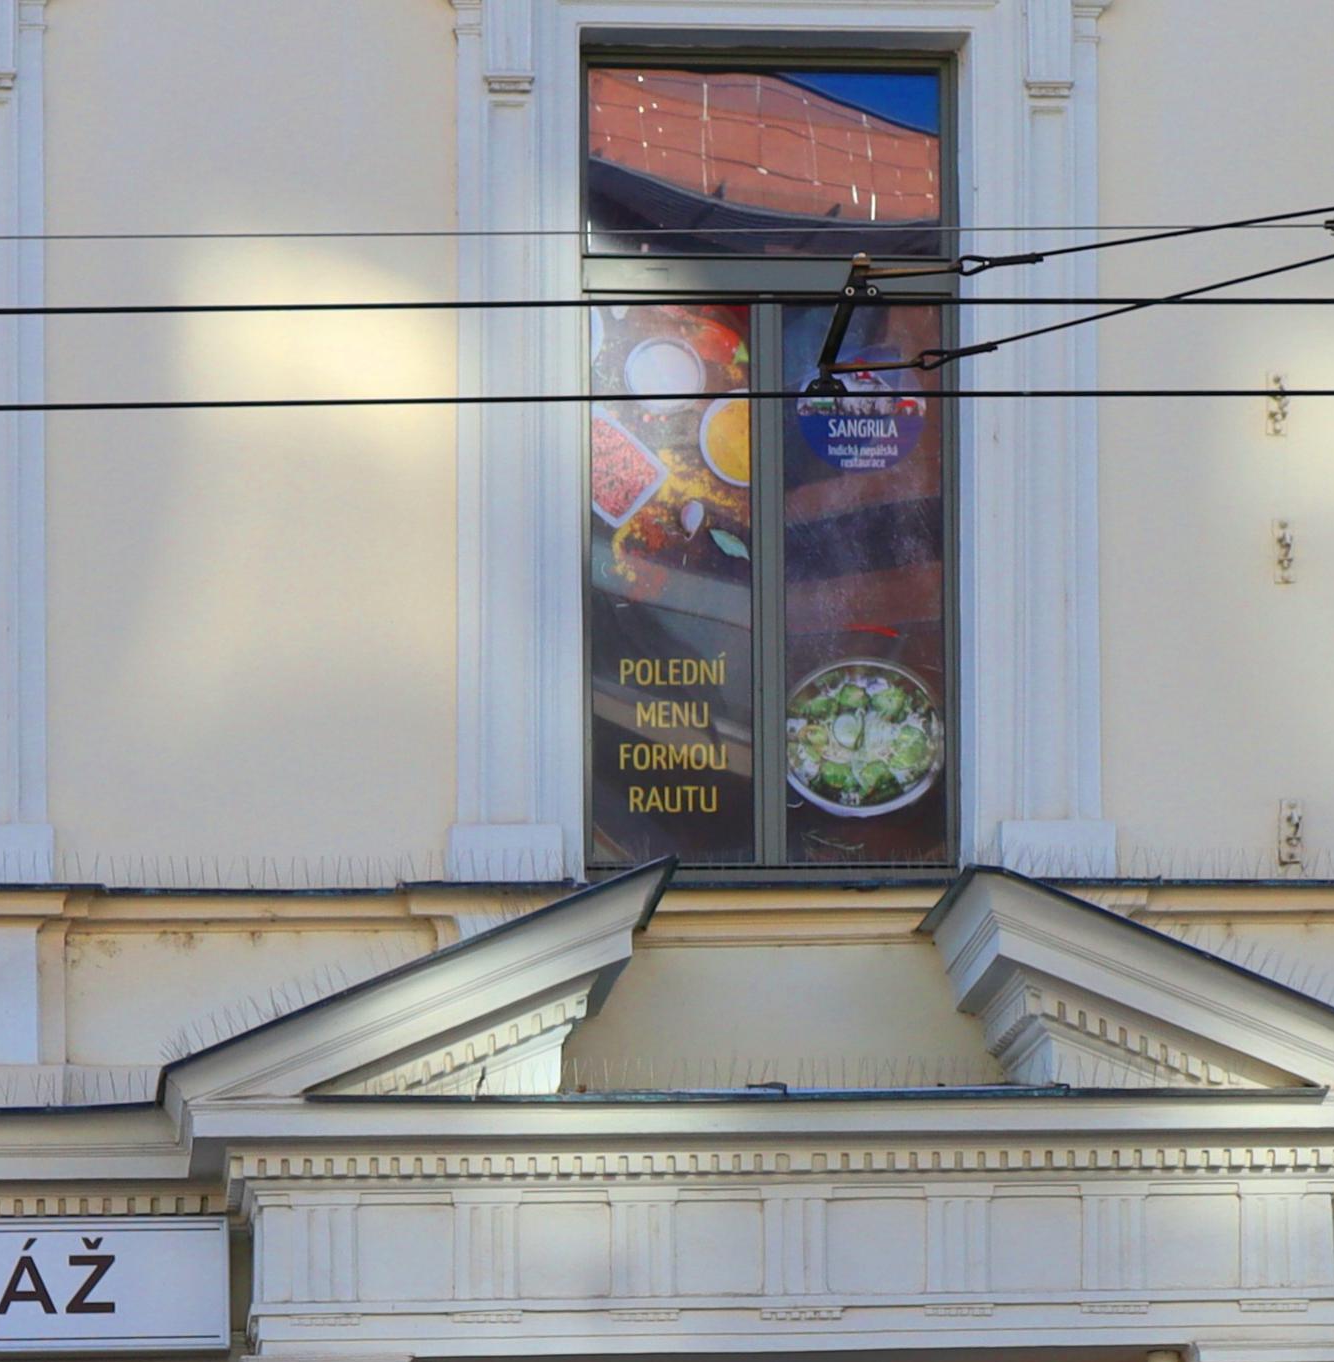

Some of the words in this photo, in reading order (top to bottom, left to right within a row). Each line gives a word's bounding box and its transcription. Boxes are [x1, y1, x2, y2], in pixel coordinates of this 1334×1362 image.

[828, 419, 898, 438] SANGRILA
[619, 652, 726, 685] POLEDNÍ
[636, 703, 709, 729] MENU
[619, 744, 728, 771] FORMOU
[629, 787, 717, 813] RAUTU
